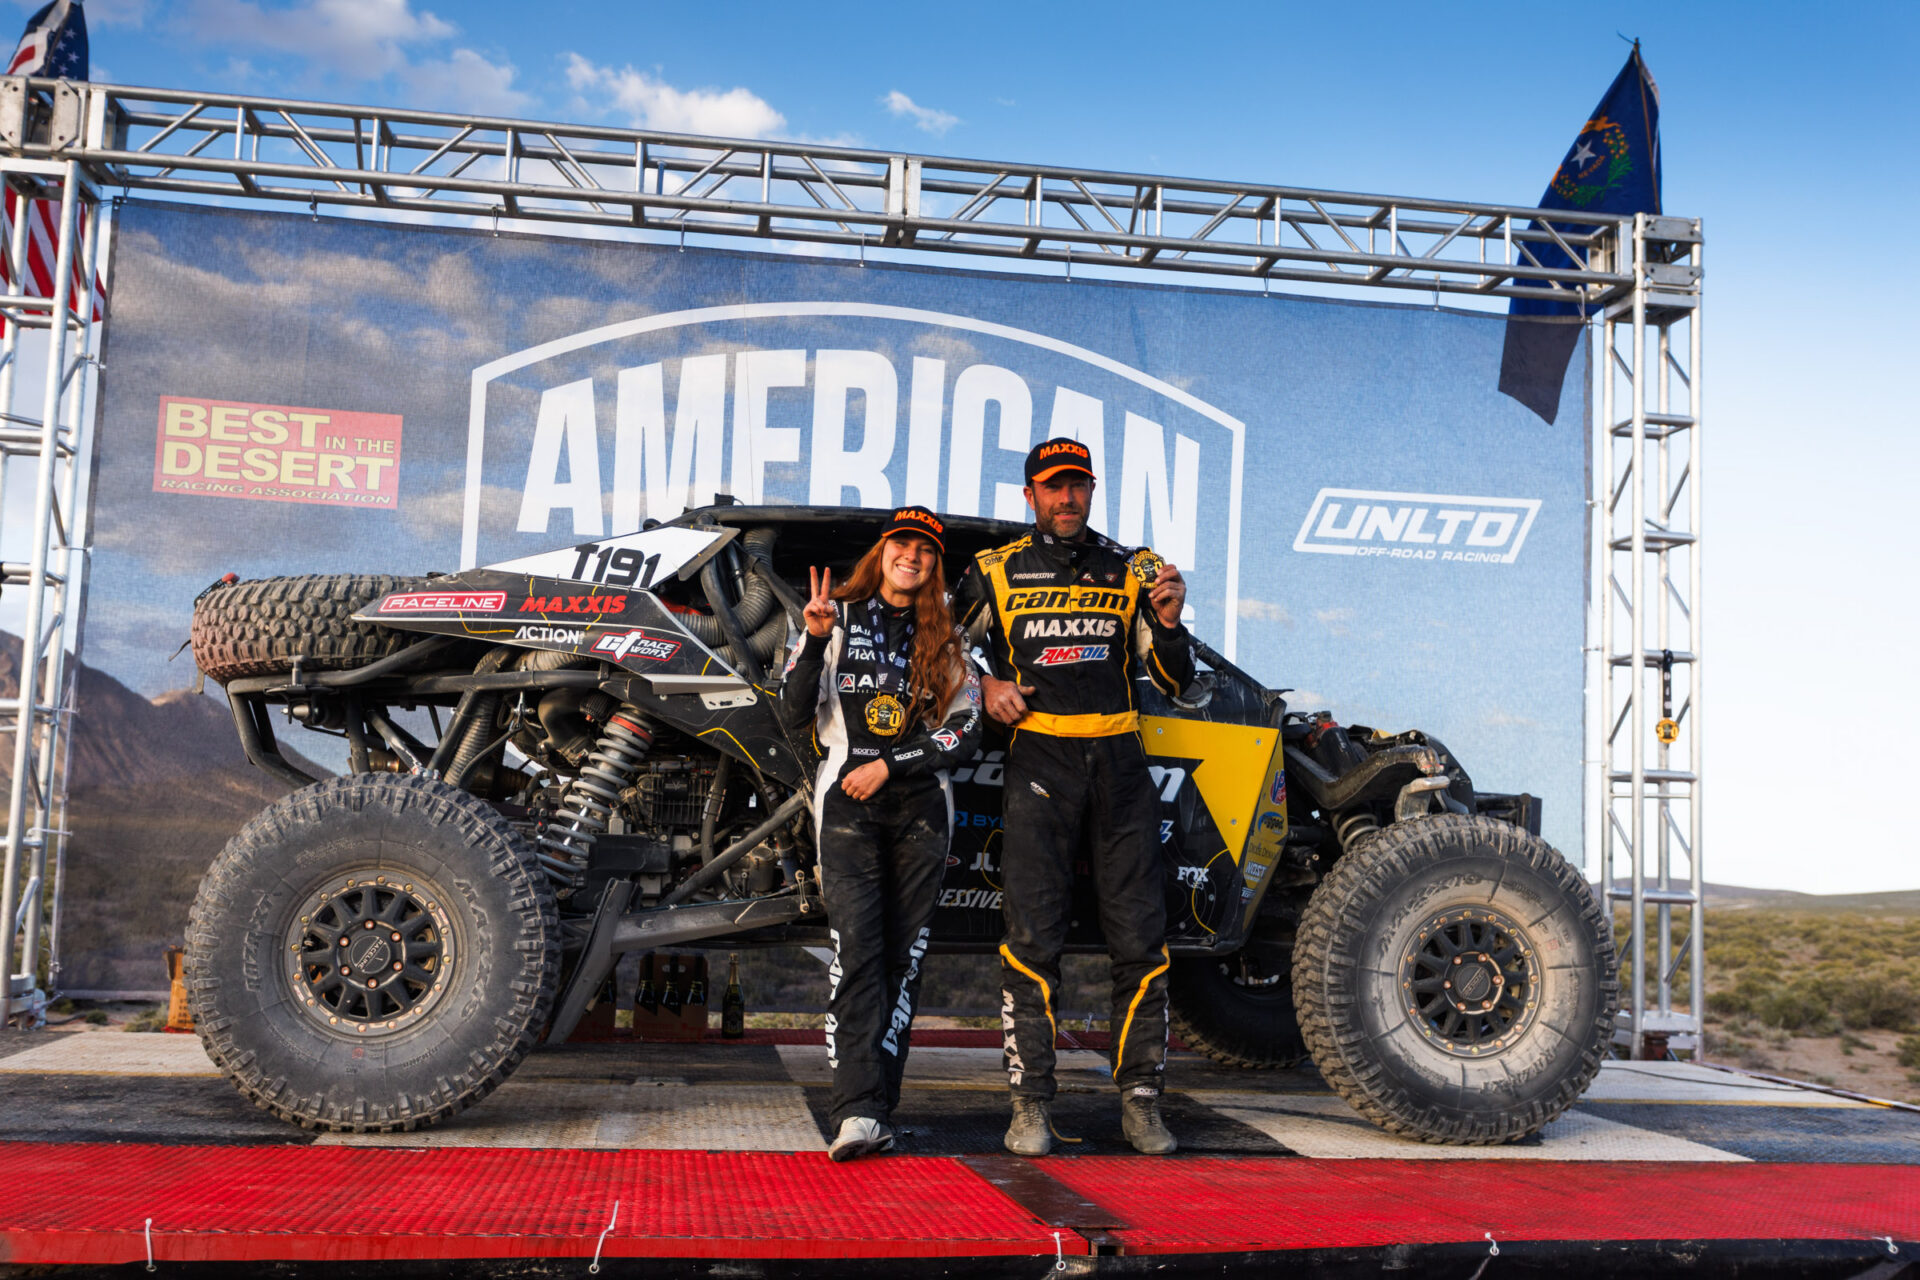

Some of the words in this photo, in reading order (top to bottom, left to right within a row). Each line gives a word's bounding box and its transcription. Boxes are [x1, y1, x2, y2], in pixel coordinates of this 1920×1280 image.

[165, 402, 331, 448] BEST
[324, 436, 346, 451] IN
[354, 438, 395, 454] THE
[517, 349, 1200, 572] AMERICAN
[1040, 443, 1089, 460] MAXXIS
[162, 440, 394, 491] DESERT
[160, 479, 245, 494] RACING
[249, 486, 391, 505] ASSOCIATION
[894, 510, 944, 534] MAXXIS
[1314, 503, 1519, 547] UNLTD
[1356, 545, 1437, 561] OFF-ROAD
[1441, 550, 1502, 563] RACING
[570, 544, 662, 588] T191
[1012, 572, 1057, 581] PROGRESSIVE
[388, 596, 498, 610] RACELINE
[518, 595, 627, 614] MAXXIS
[514, 626, 580, 645] ACTION
[1023, 618, 1117, 639] MAXXIS
[630, 645, 672, 659] WORX
[638, 639, 676, 651] RACE
[1036, 645, 1110, 667] AMSOIL
[852, 747, 880, 756] sparco
[894, 749, 924, 762] sparco
[1177, 866, 1210, 888] FOX
[936, 888, 1004, 910] ESSIVE
[453, 879, 493, 1021] MAXXIS
[1002, 988, 1025, 1086] MAXXIS
